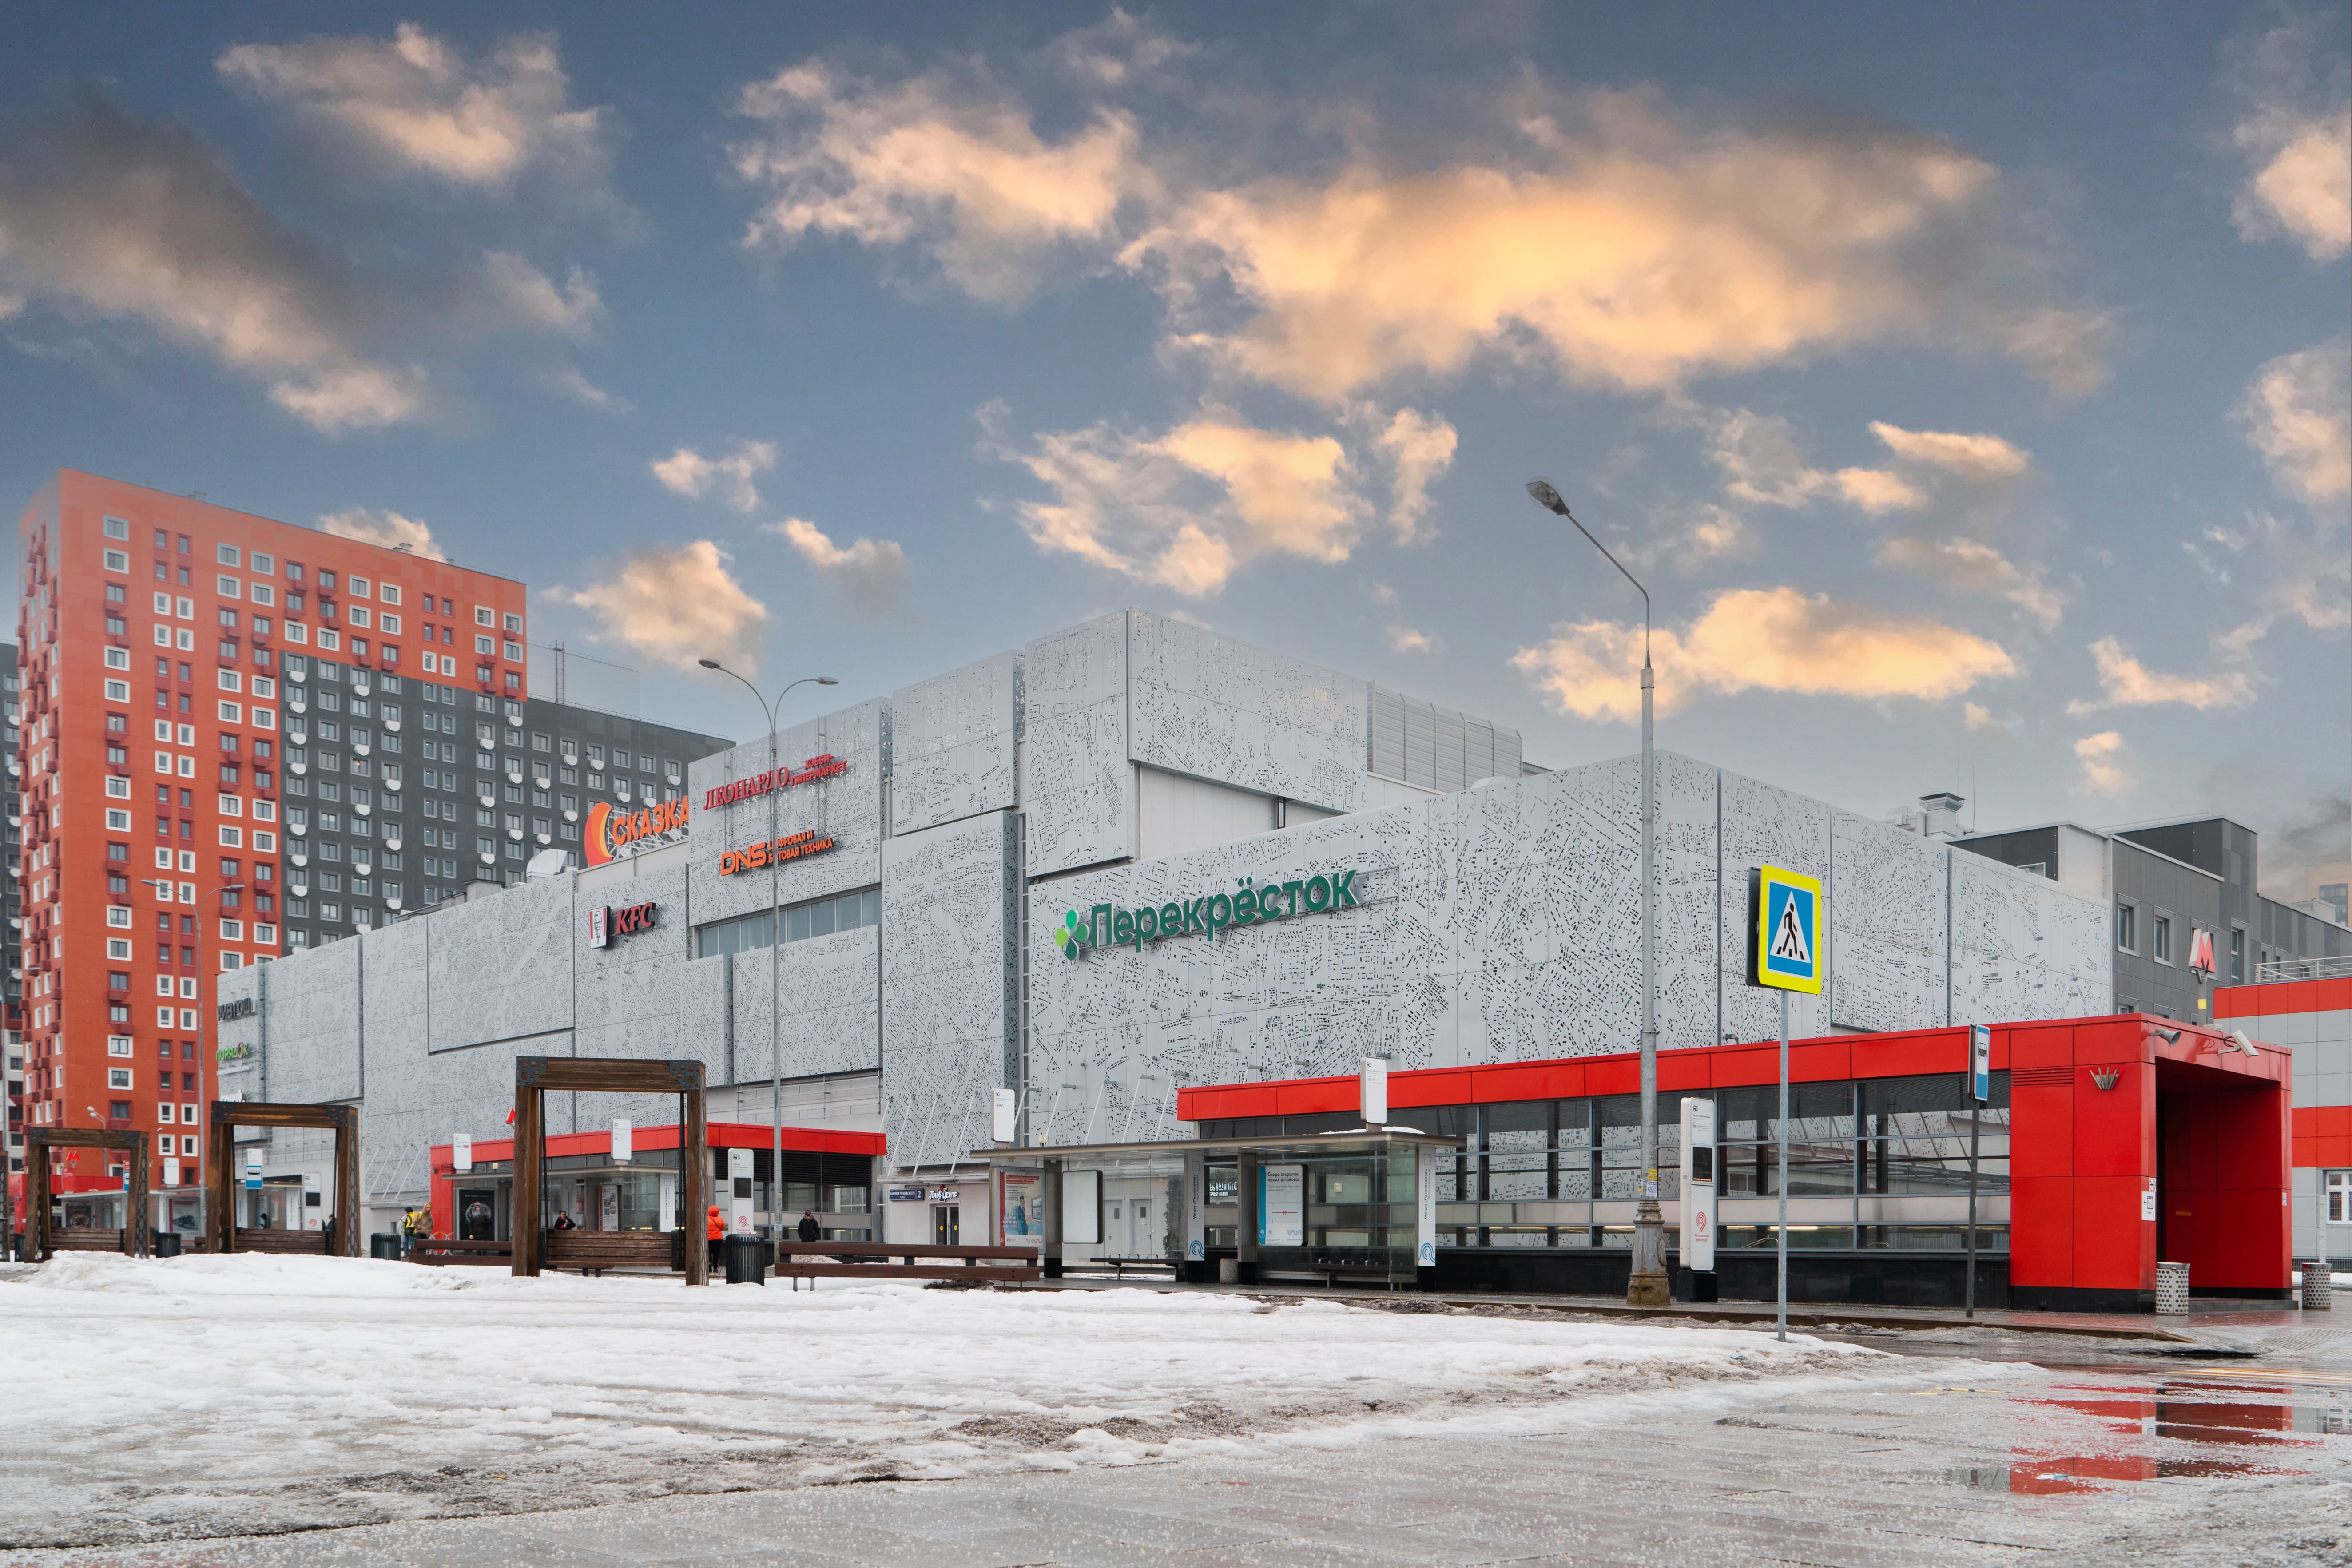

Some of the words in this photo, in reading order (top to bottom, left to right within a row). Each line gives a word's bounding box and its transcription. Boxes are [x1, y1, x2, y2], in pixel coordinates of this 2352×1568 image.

[791, 761, 847, 786] ГИПЕРМАРКЕТ
[805, 753, 835, 770] ХОББИ-
[703, 766, 790, 810] ЛЕОНАРДО
[612, 795, 689, 846] СКАЗКА
[807, 829, 814, 840] И
[721, 842, 767, 876] DNS
[768, 846, 799, 863] БТОВАЯ
[801, 838, 834, 855] ТЕХНИКА
[615, 902, 656, 935] KFC
[1091, 869, 1358, 953] Перекрёсток
[216, 1041, 249, 1061] ПОРЯДОК
[928, 1190, 942, 1200] Плов
